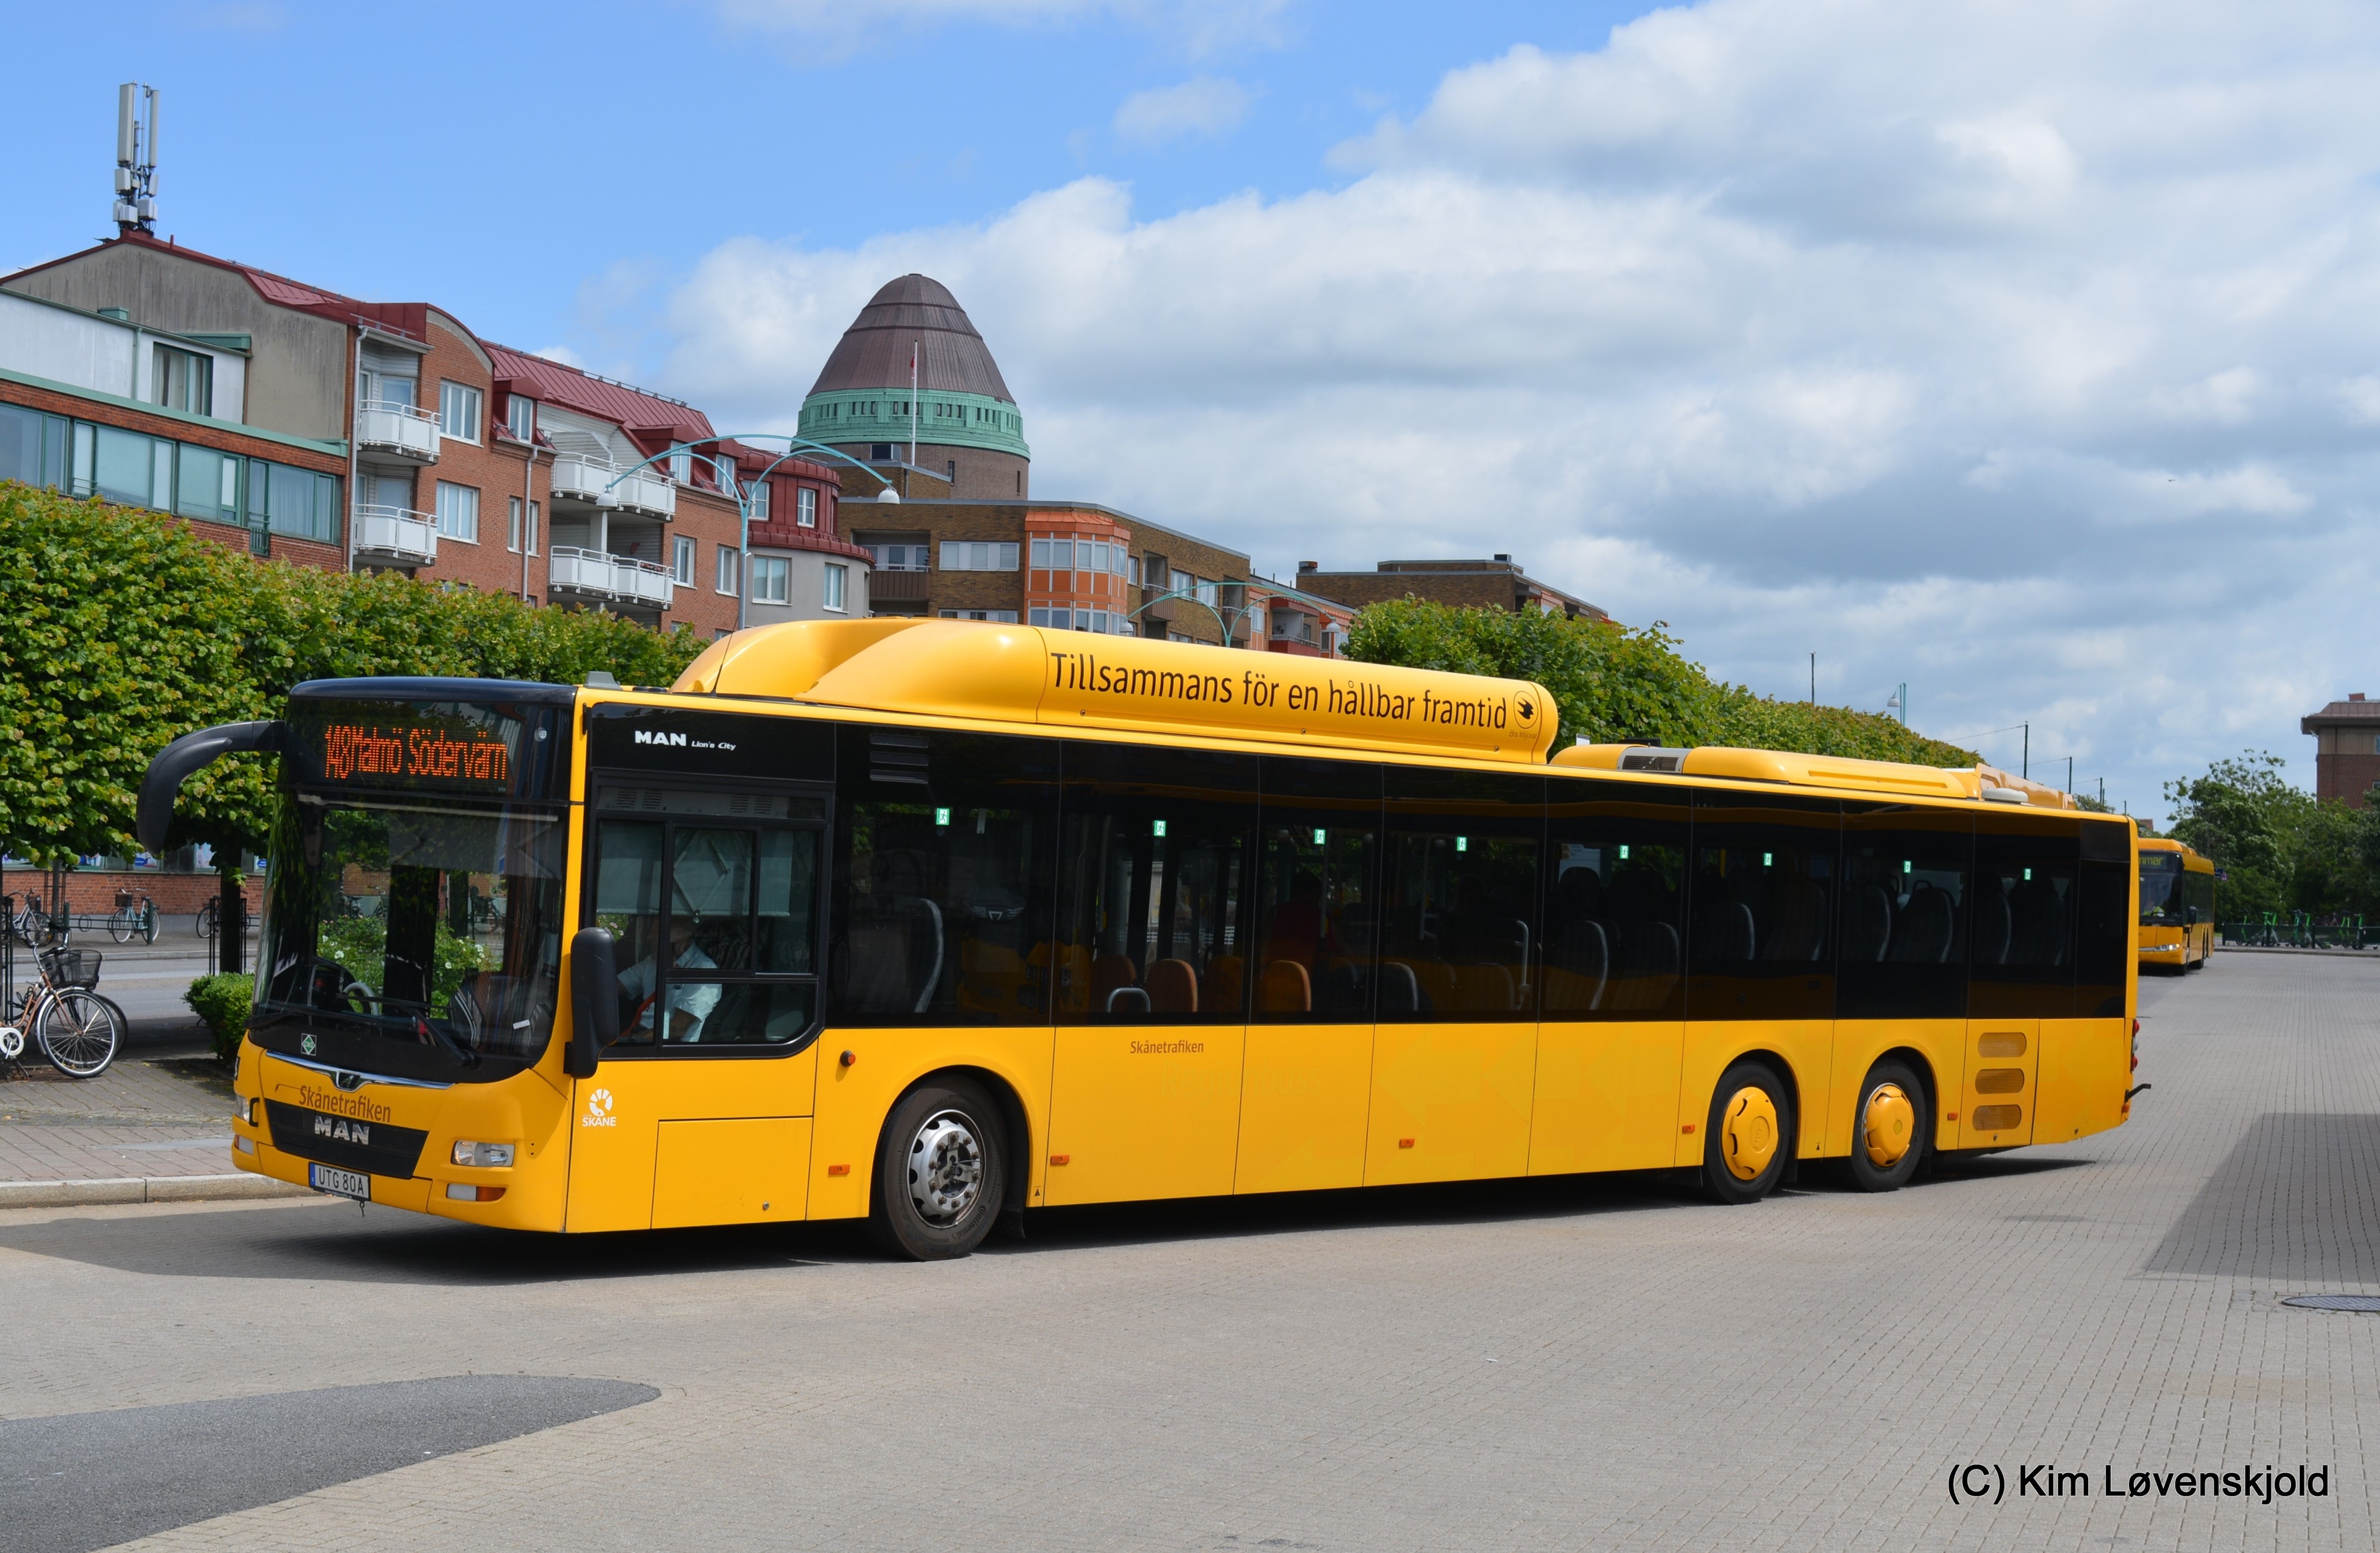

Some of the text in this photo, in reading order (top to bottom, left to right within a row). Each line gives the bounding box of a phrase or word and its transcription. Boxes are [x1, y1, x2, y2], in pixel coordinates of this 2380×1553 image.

[1051, 652, 1506, 729] Tillsammans för en hållbar framtid
[351, 725, 402, 773] Malmö
[408, 728, 507, 780] Södervärn
[635, 730, 736, 751] MAN Lion's City
[1130, 1039, 1204, 1054] Skånetrafiken
[299, 1085, 391, 1123] Skånetrafiken
[314, 1115, 369, 1145] MAN
[319, 1167, 364, 1195] UTG 80A
